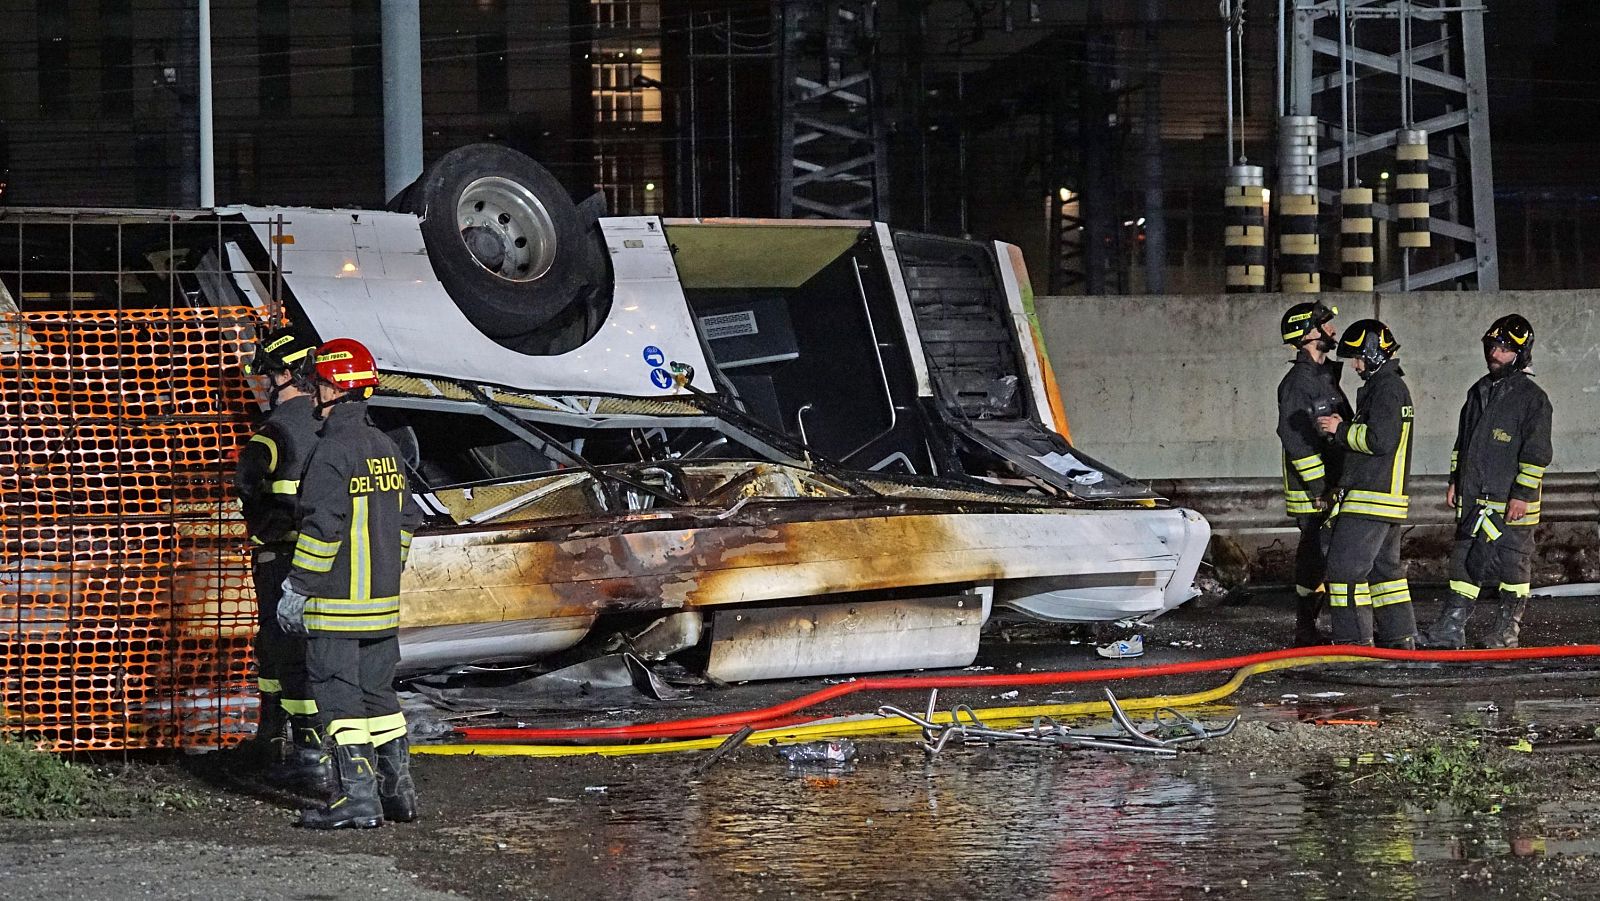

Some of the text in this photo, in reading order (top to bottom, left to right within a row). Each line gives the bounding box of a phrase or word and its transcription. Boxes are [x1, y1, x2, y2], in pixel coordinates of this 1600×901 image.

[274, 336, 289, 347] FUOCO
[330, 352, 347, 360] FUOCO
[1401, 405, 1414, 418] DEL
[366, 456, 398, 475] VGILI
[349, 476, 375, 494] DEL
